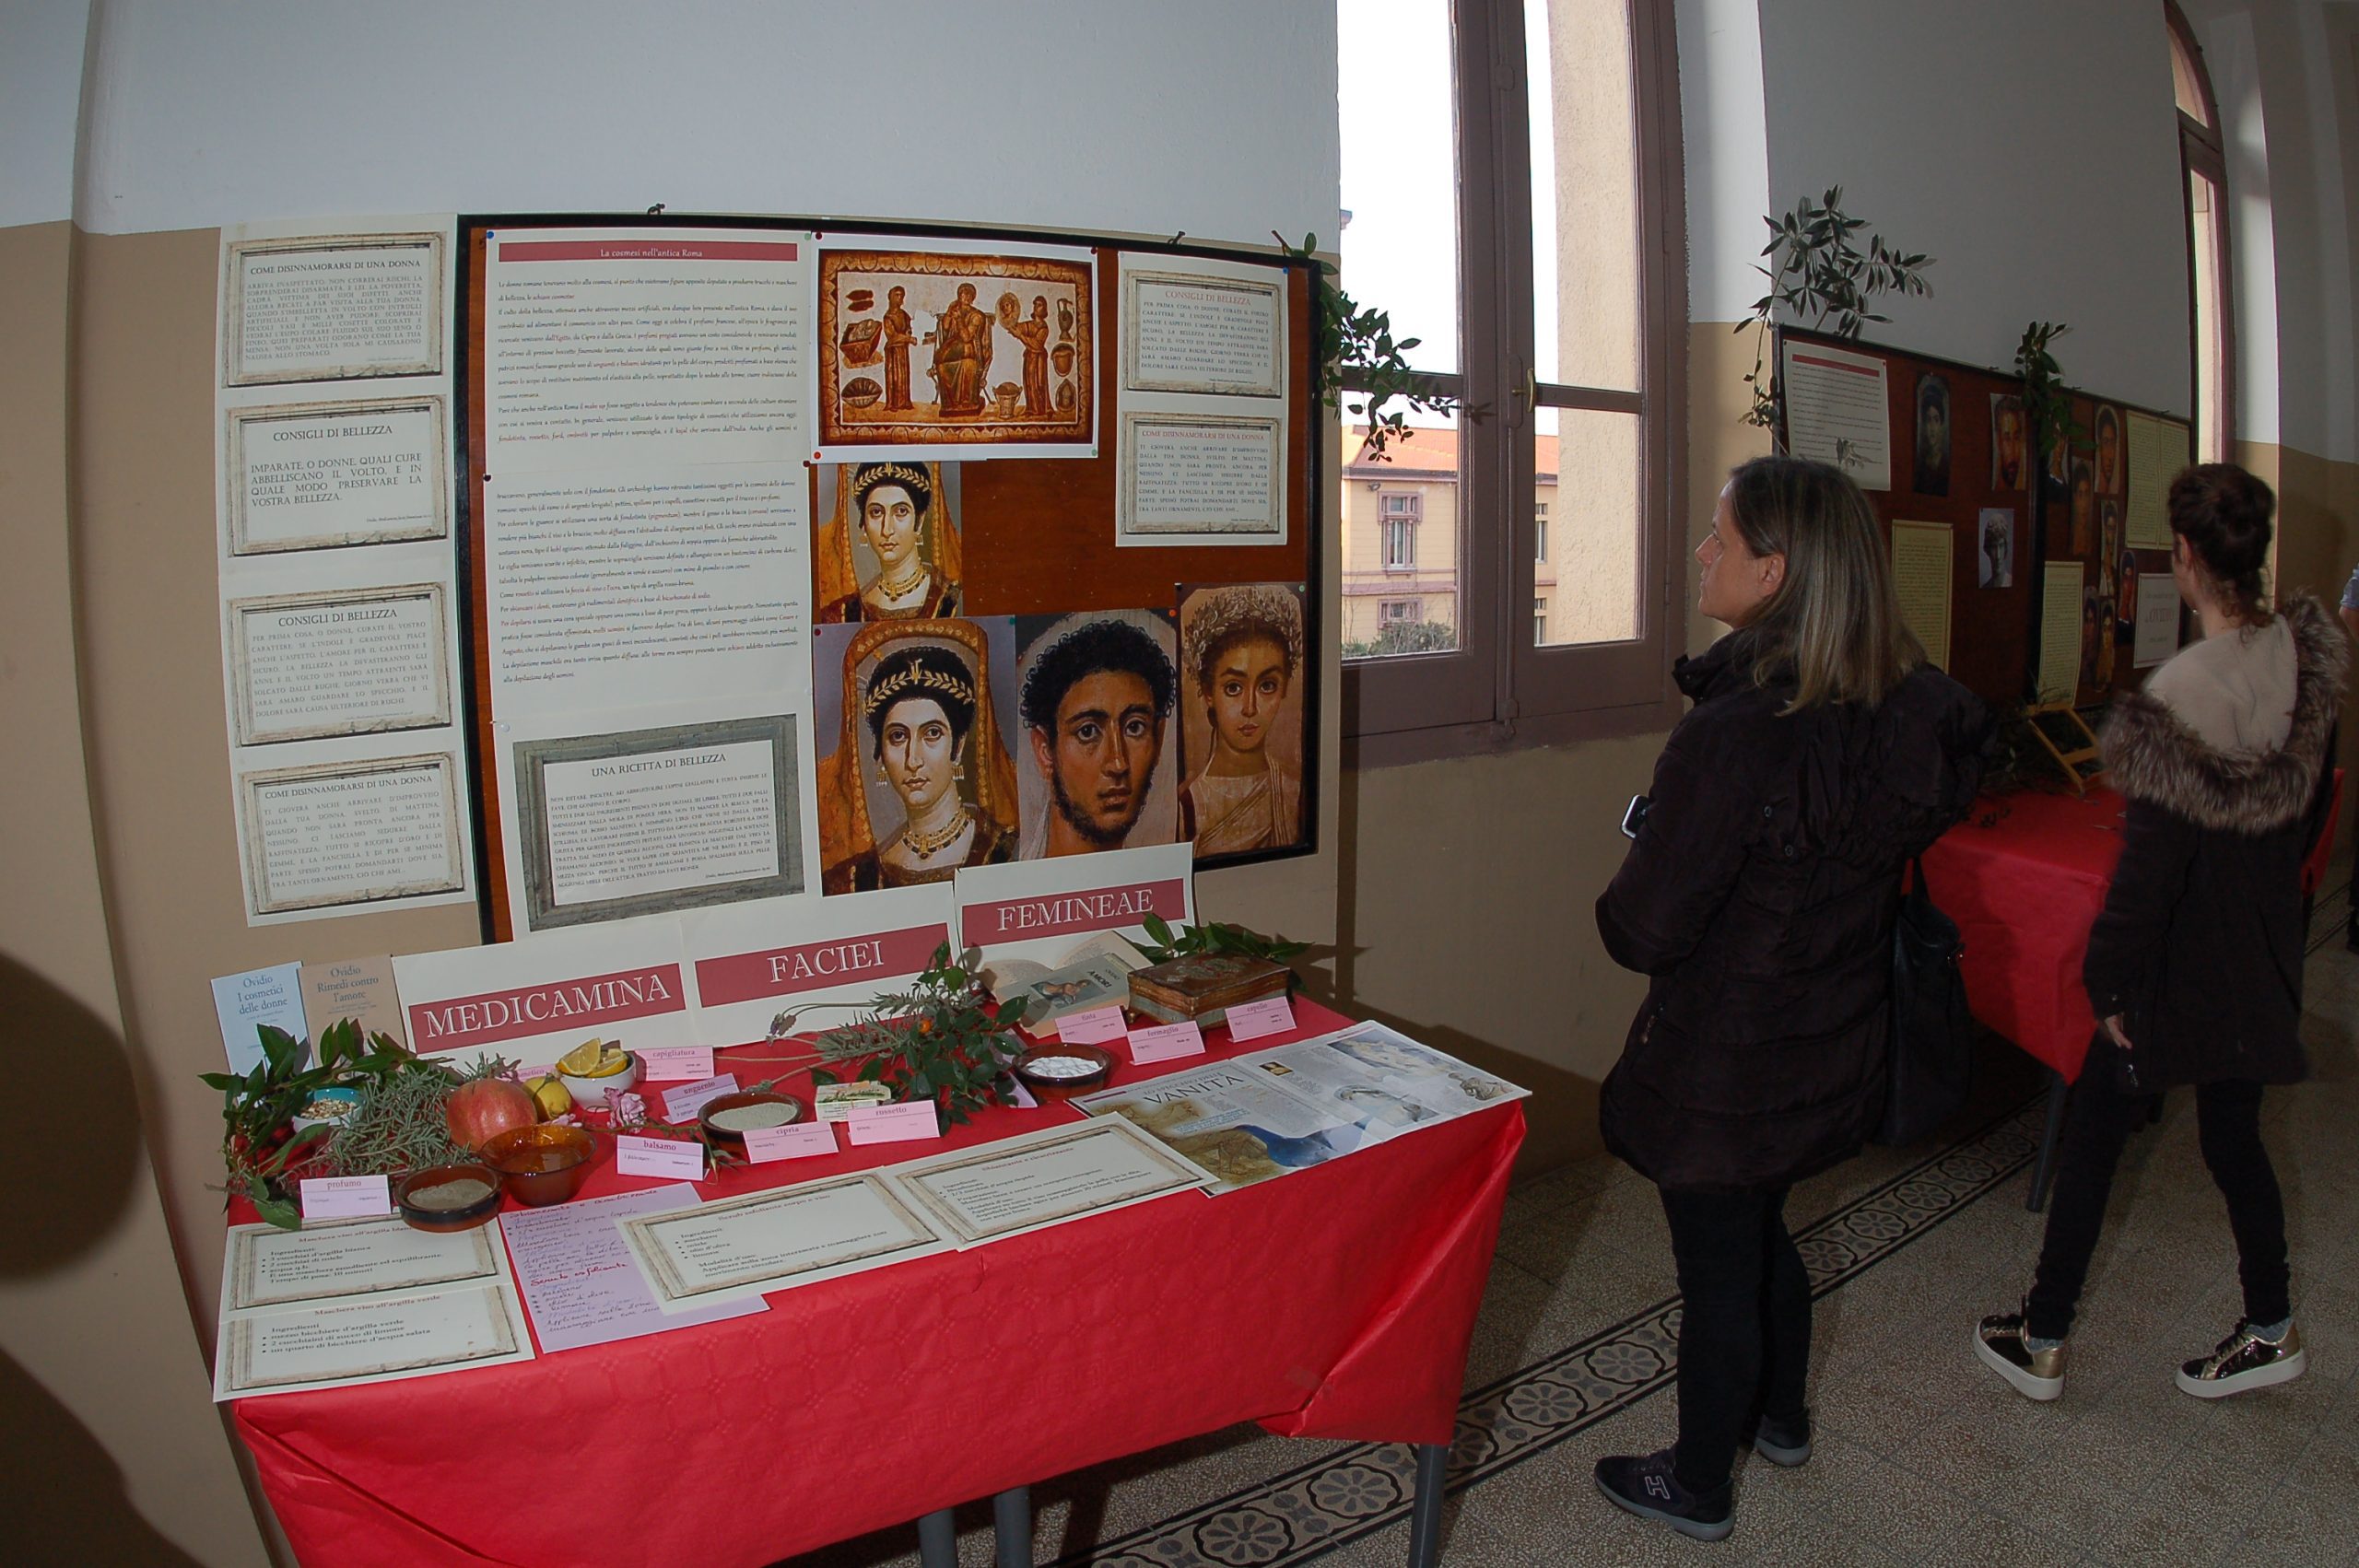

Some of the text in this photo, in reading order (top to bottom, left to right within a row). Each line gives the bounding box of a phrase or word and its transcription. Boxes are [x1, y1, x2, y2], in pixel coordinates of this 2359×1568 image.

[642, 249, 679, 257] nell'antica
[251, 266, 275, 275] COME
[278, 262, 351, 273] DISINNAMORARSI
[1165, 291, 1203, 300] CONSIGLI
[1217, 295, 1250, 305] BELLEZZA
[246, 310, 278, 318] QUANDO
[274, 426, 393, 441] CONSIGLI DI BELLEZZA
[307, 461, 315, 469] O
[359, 455, 392, 464] QUALI
[395, 453, 421, 462] CURE
[252, 472, 323, 485] ABBELLISCANO
[333, 470, 342, 478] IL
[396, 465, 402, 474] E
[411, 464, 421, 473] IN
[252, 486, 285, 496] QUALE
[296, 483, 328, 492] MODO
[339, 477, 398, 489] PRESERVARE
[252, 493, 343, 507] VOSTRA BELLEZZA.
[279, 609, 397, 626] CONSIGLI DI BELLEZZA
[592, 754, 726, 778] UNA RICETTA DI BELLEZZA
[265, 790, 288, 799] COME
[292, 782, 364, 797] DISINNAMORARSI
[401, 776, 432, 785] DONNA
[997, 888, 1154, 931] FEMINEAE
[768, 941, 885, 983] FACIEI
[330, 965, 361, 978] Ovidio
[1087, 970, 1112, 988] AMORI
[243, 975, 274, 989] Ovidio
[317, 977, 379, 993] Rimedi contro
[238, 984, 283, 1002] I cosmetici
[334, 991, 366, 1003] l'amore
[240, 999, 288, 1015] delle donne
[424, 974, 672, 1038] MEDICAMINA
[652, 1049, 695, 1059] capigliatura
[684, 1080, 716, 1095] unguento
[875, 1106, 907, 1117] rossetto
[776, 1126, 800, 1135] cipria
[644, 1141, 676, 1151] balsamo
[327, 1180, 362, 1190] profumo
